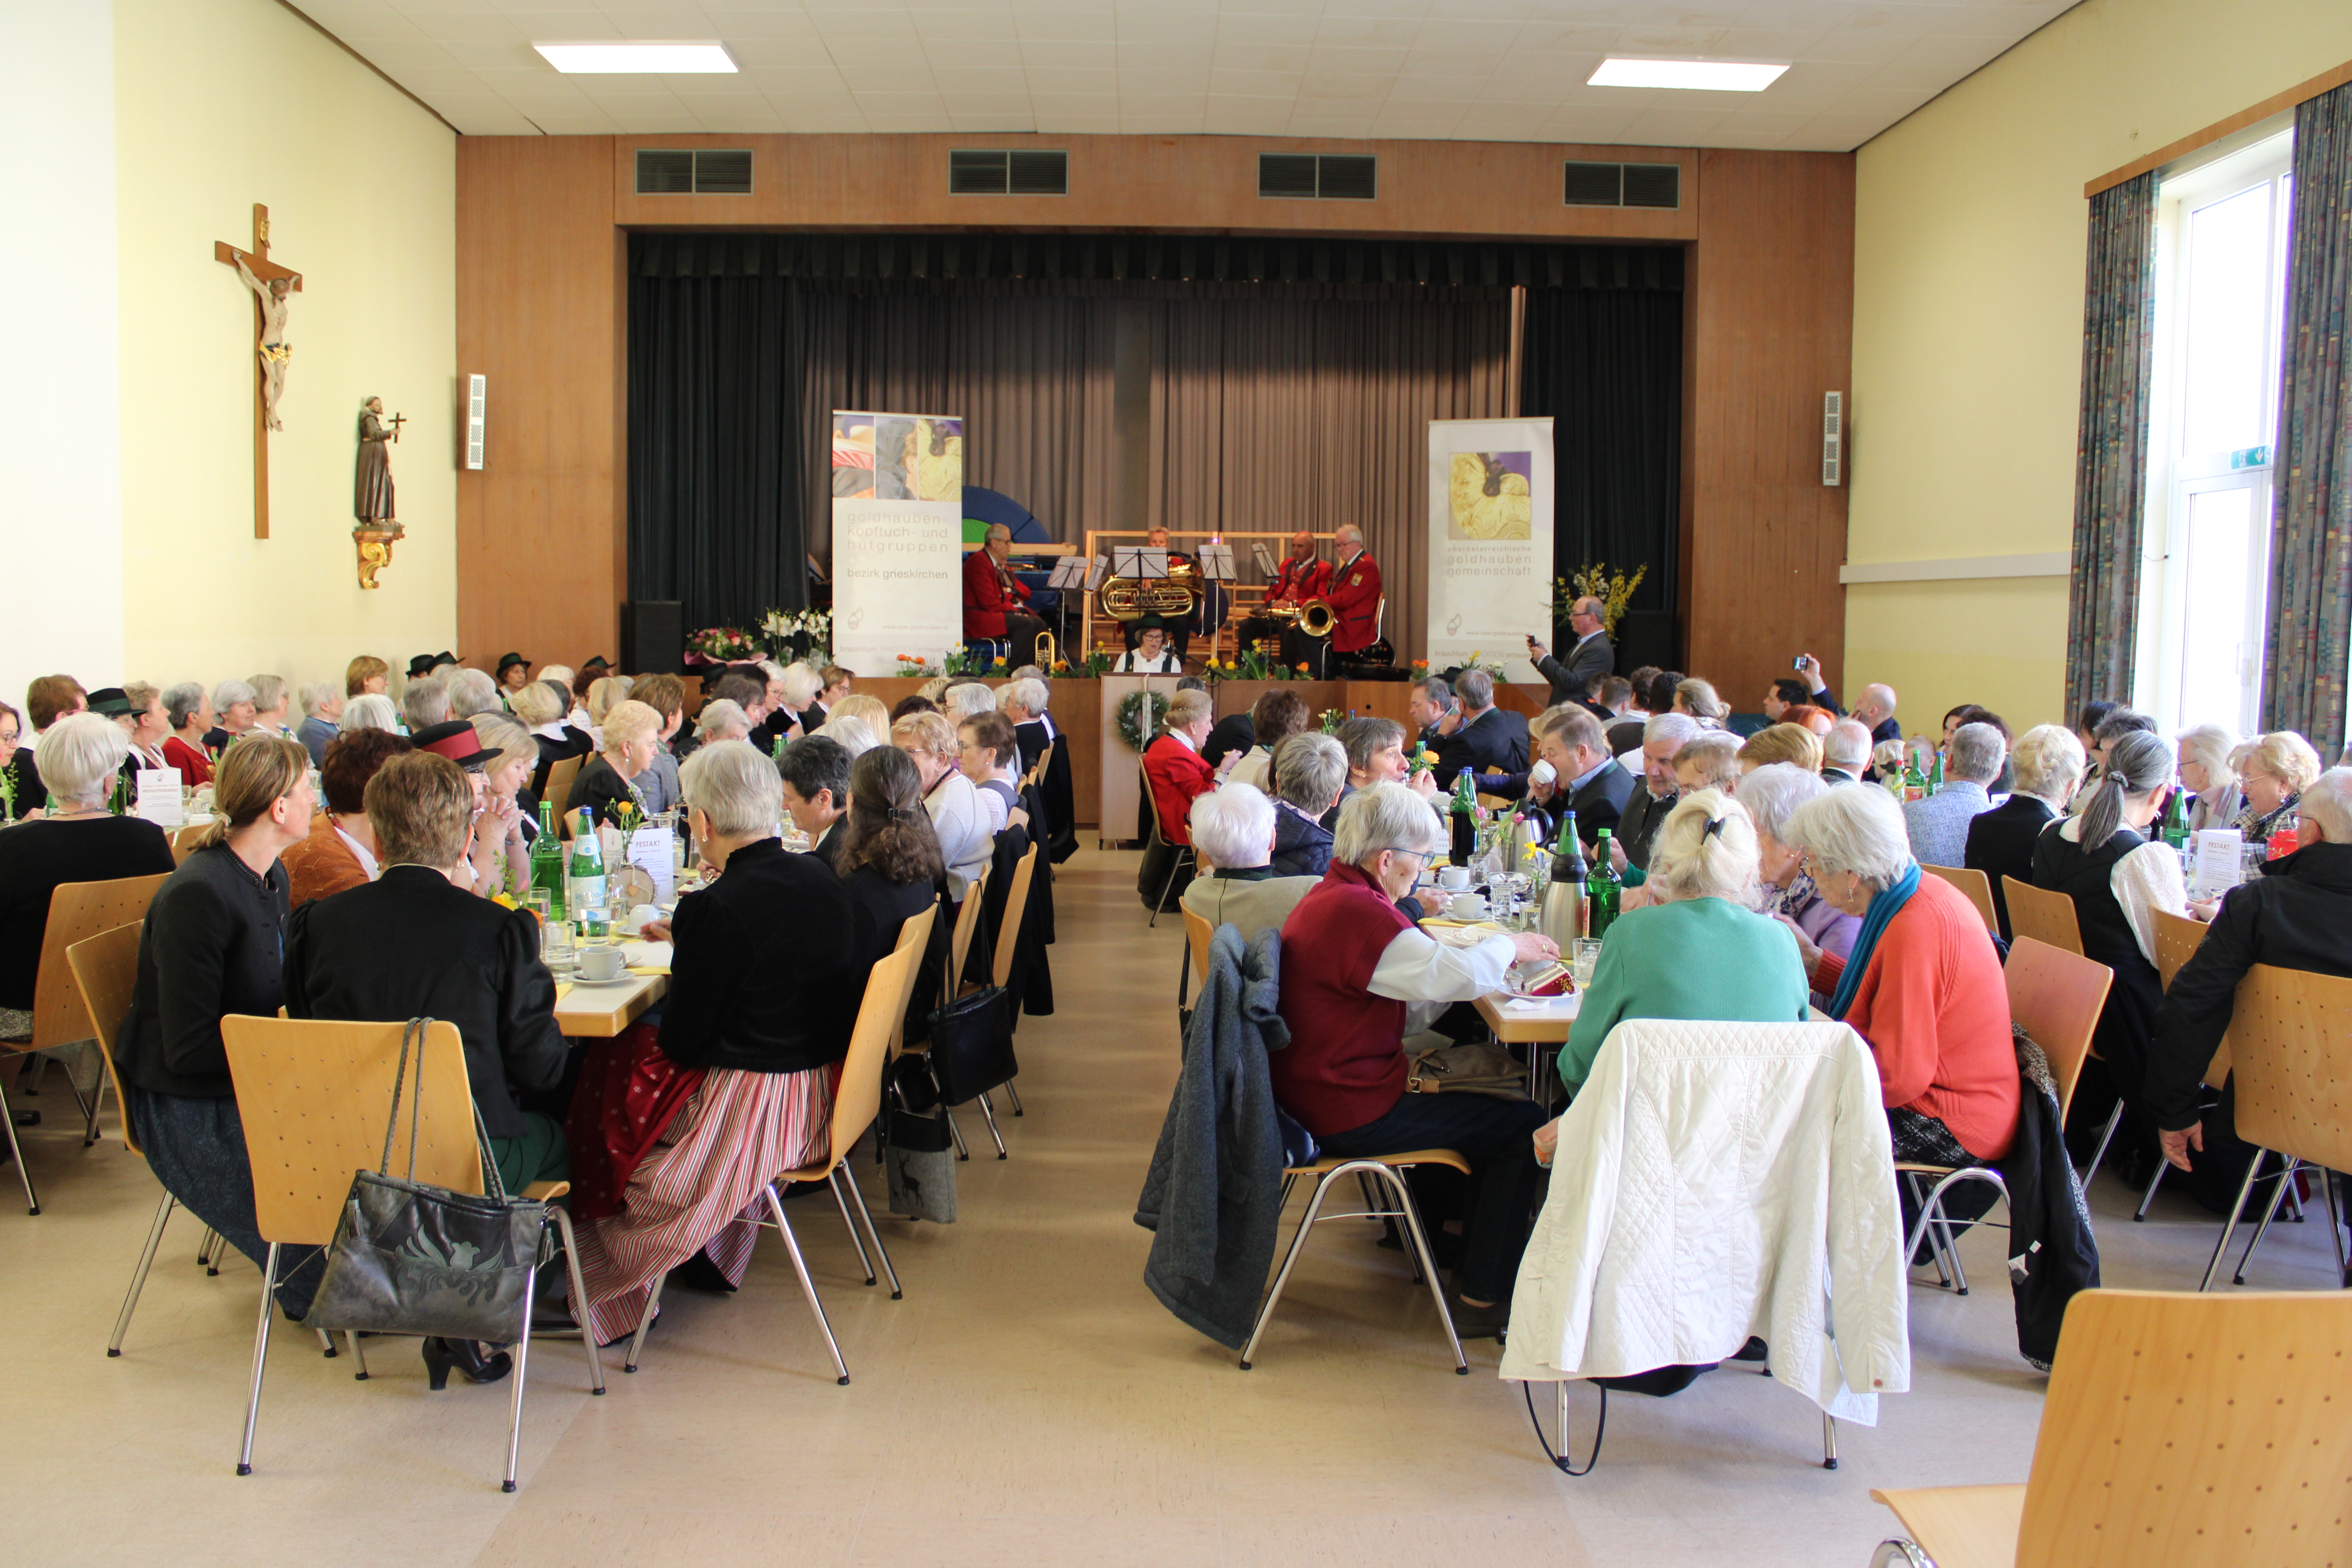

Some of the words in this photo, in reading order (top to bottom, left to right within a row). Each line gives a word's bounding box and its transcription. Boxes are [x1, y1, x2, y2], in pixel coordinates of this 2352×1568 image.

[847, 512, 947, 524] goldhauben-
[848, 526, 916, 538] kopftuch-
[922, 527, 947, 538] und
[847, 539, 948, 553] hutgruppen
[1448, 554, 1531, 566] goldhauben
[847, 567, 880, 577] bezirk
[882, 569, 948, 580] grieskirchen
[1447, 566, 1531, 577] gemeinschaft
[2208, 842, 2230, 850] FESTAKT
